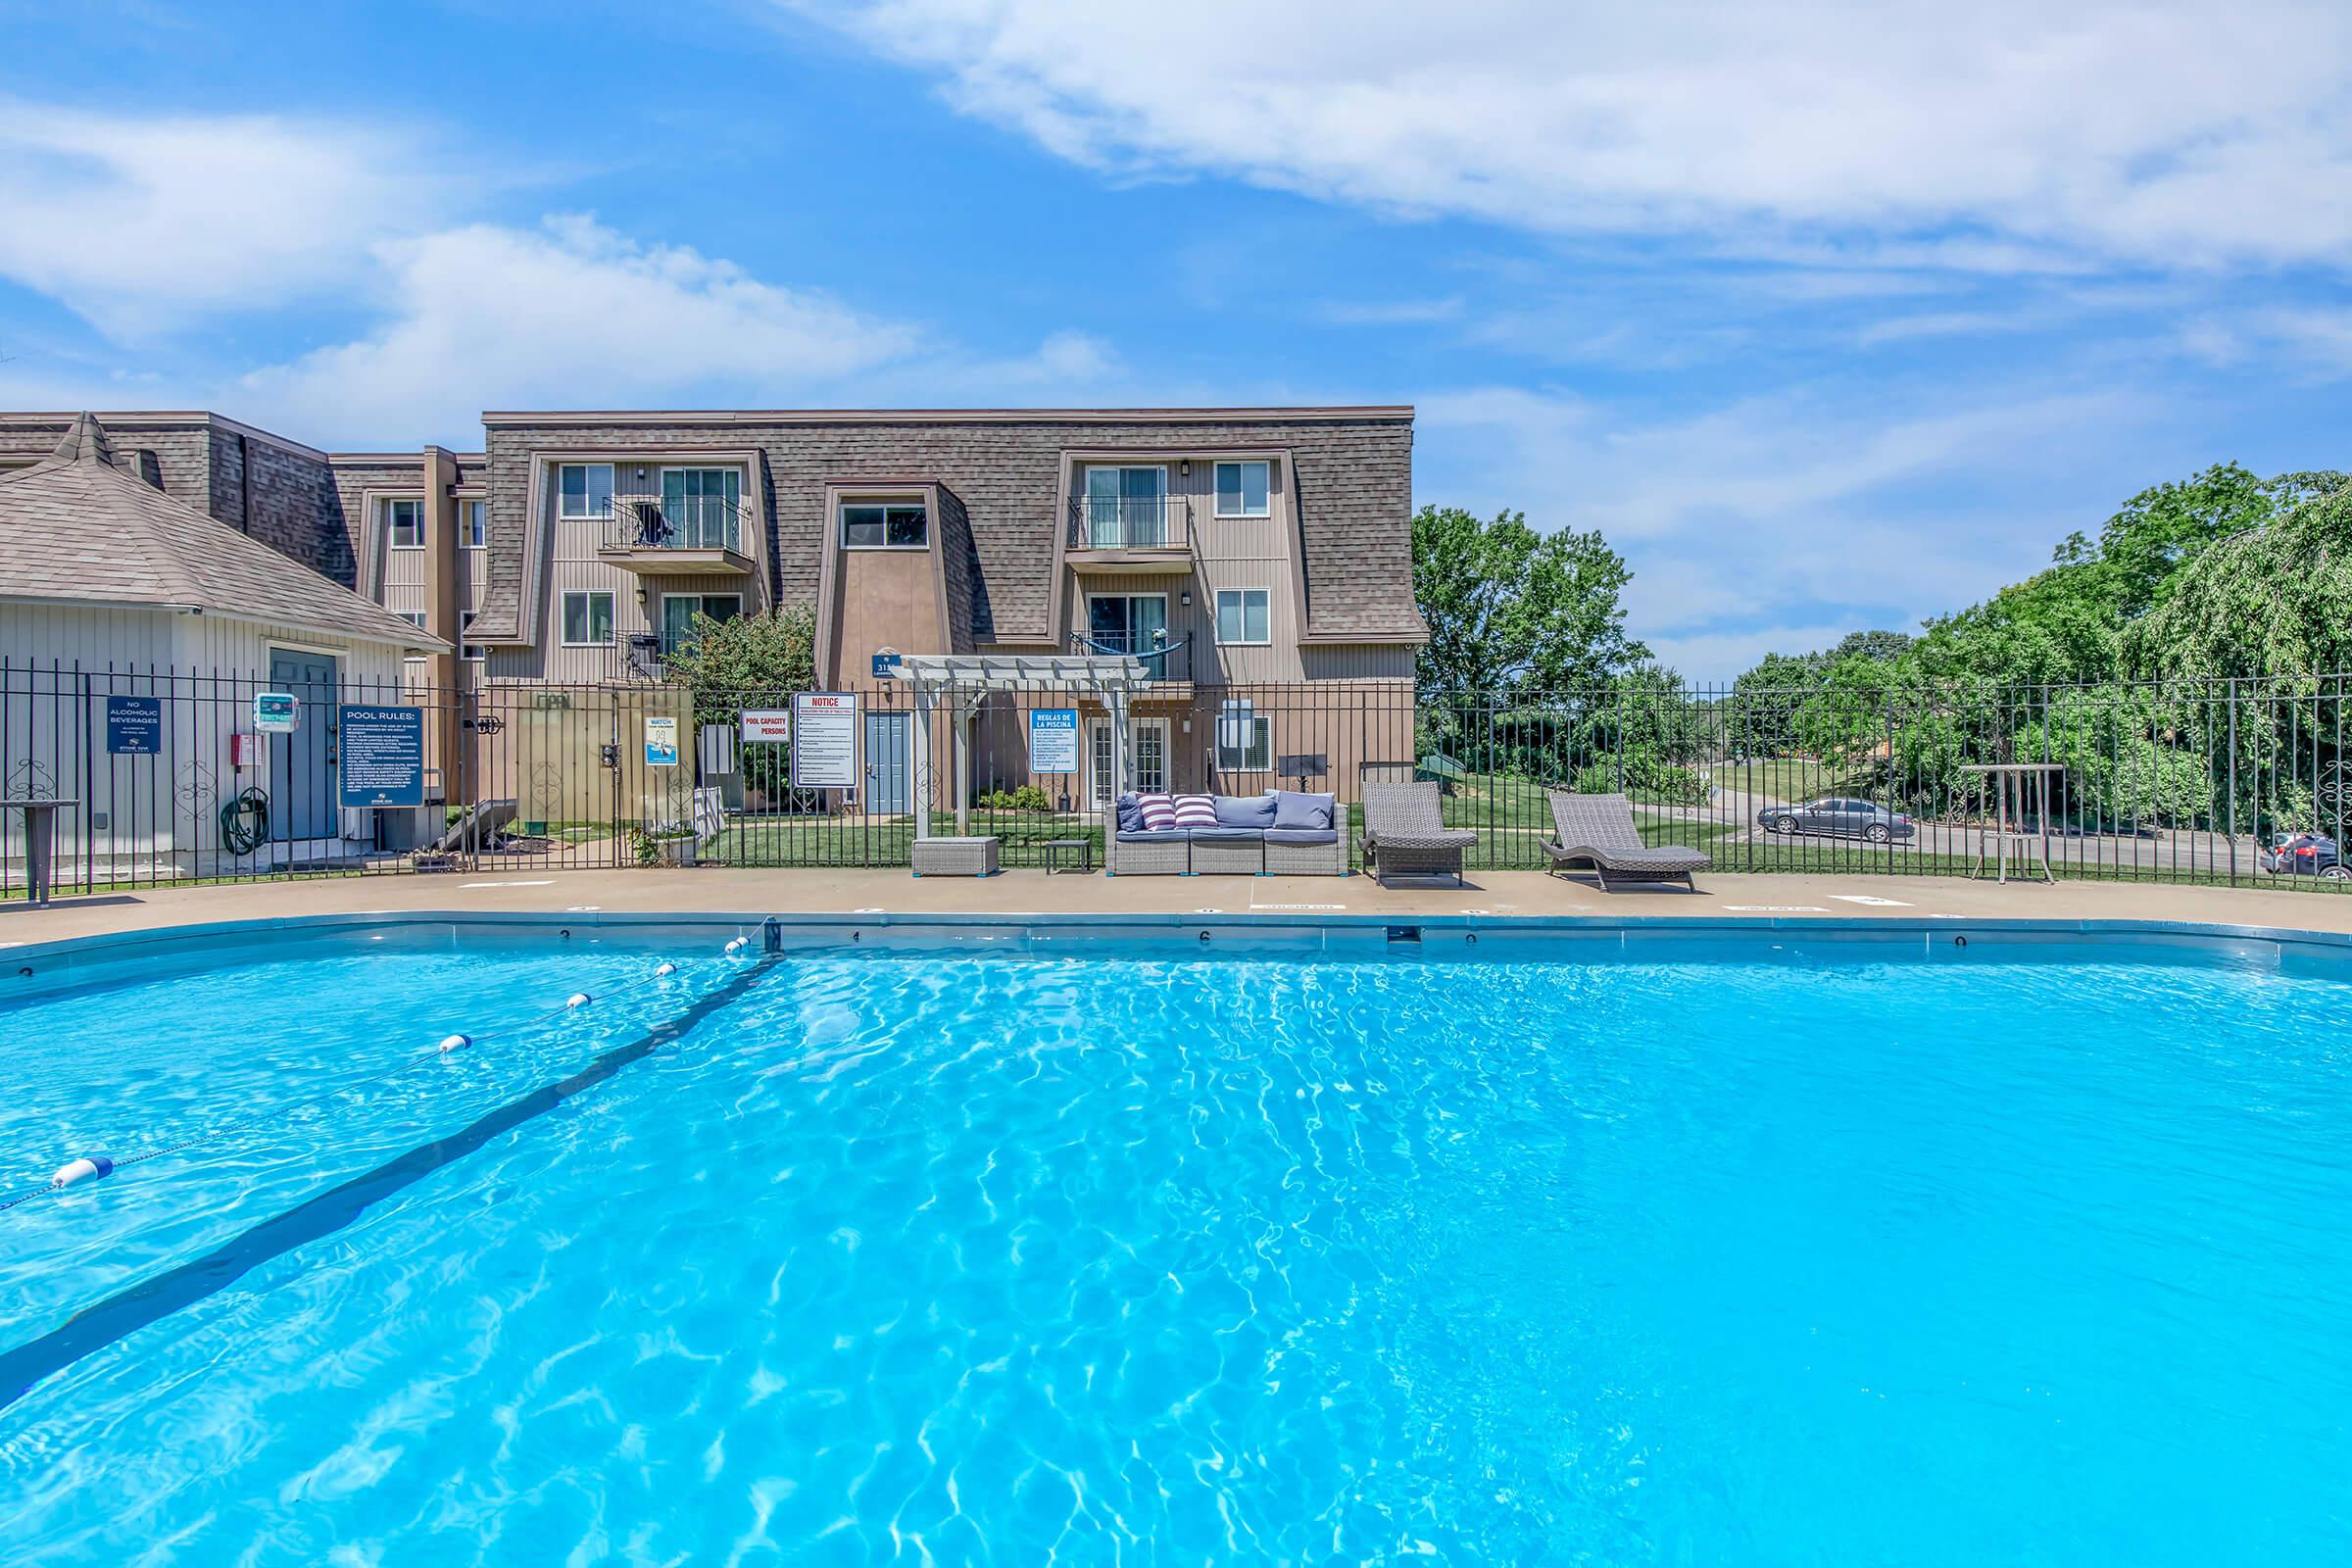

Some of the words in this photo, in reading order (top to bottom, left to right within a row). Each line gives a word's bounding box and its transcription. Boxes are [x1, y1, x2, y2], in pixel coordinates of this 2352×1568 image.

[811, 697, 840, 707] NOTICE
[347, 711, 377, 720] POOL
[378, 711, 416, 720] RULES:
